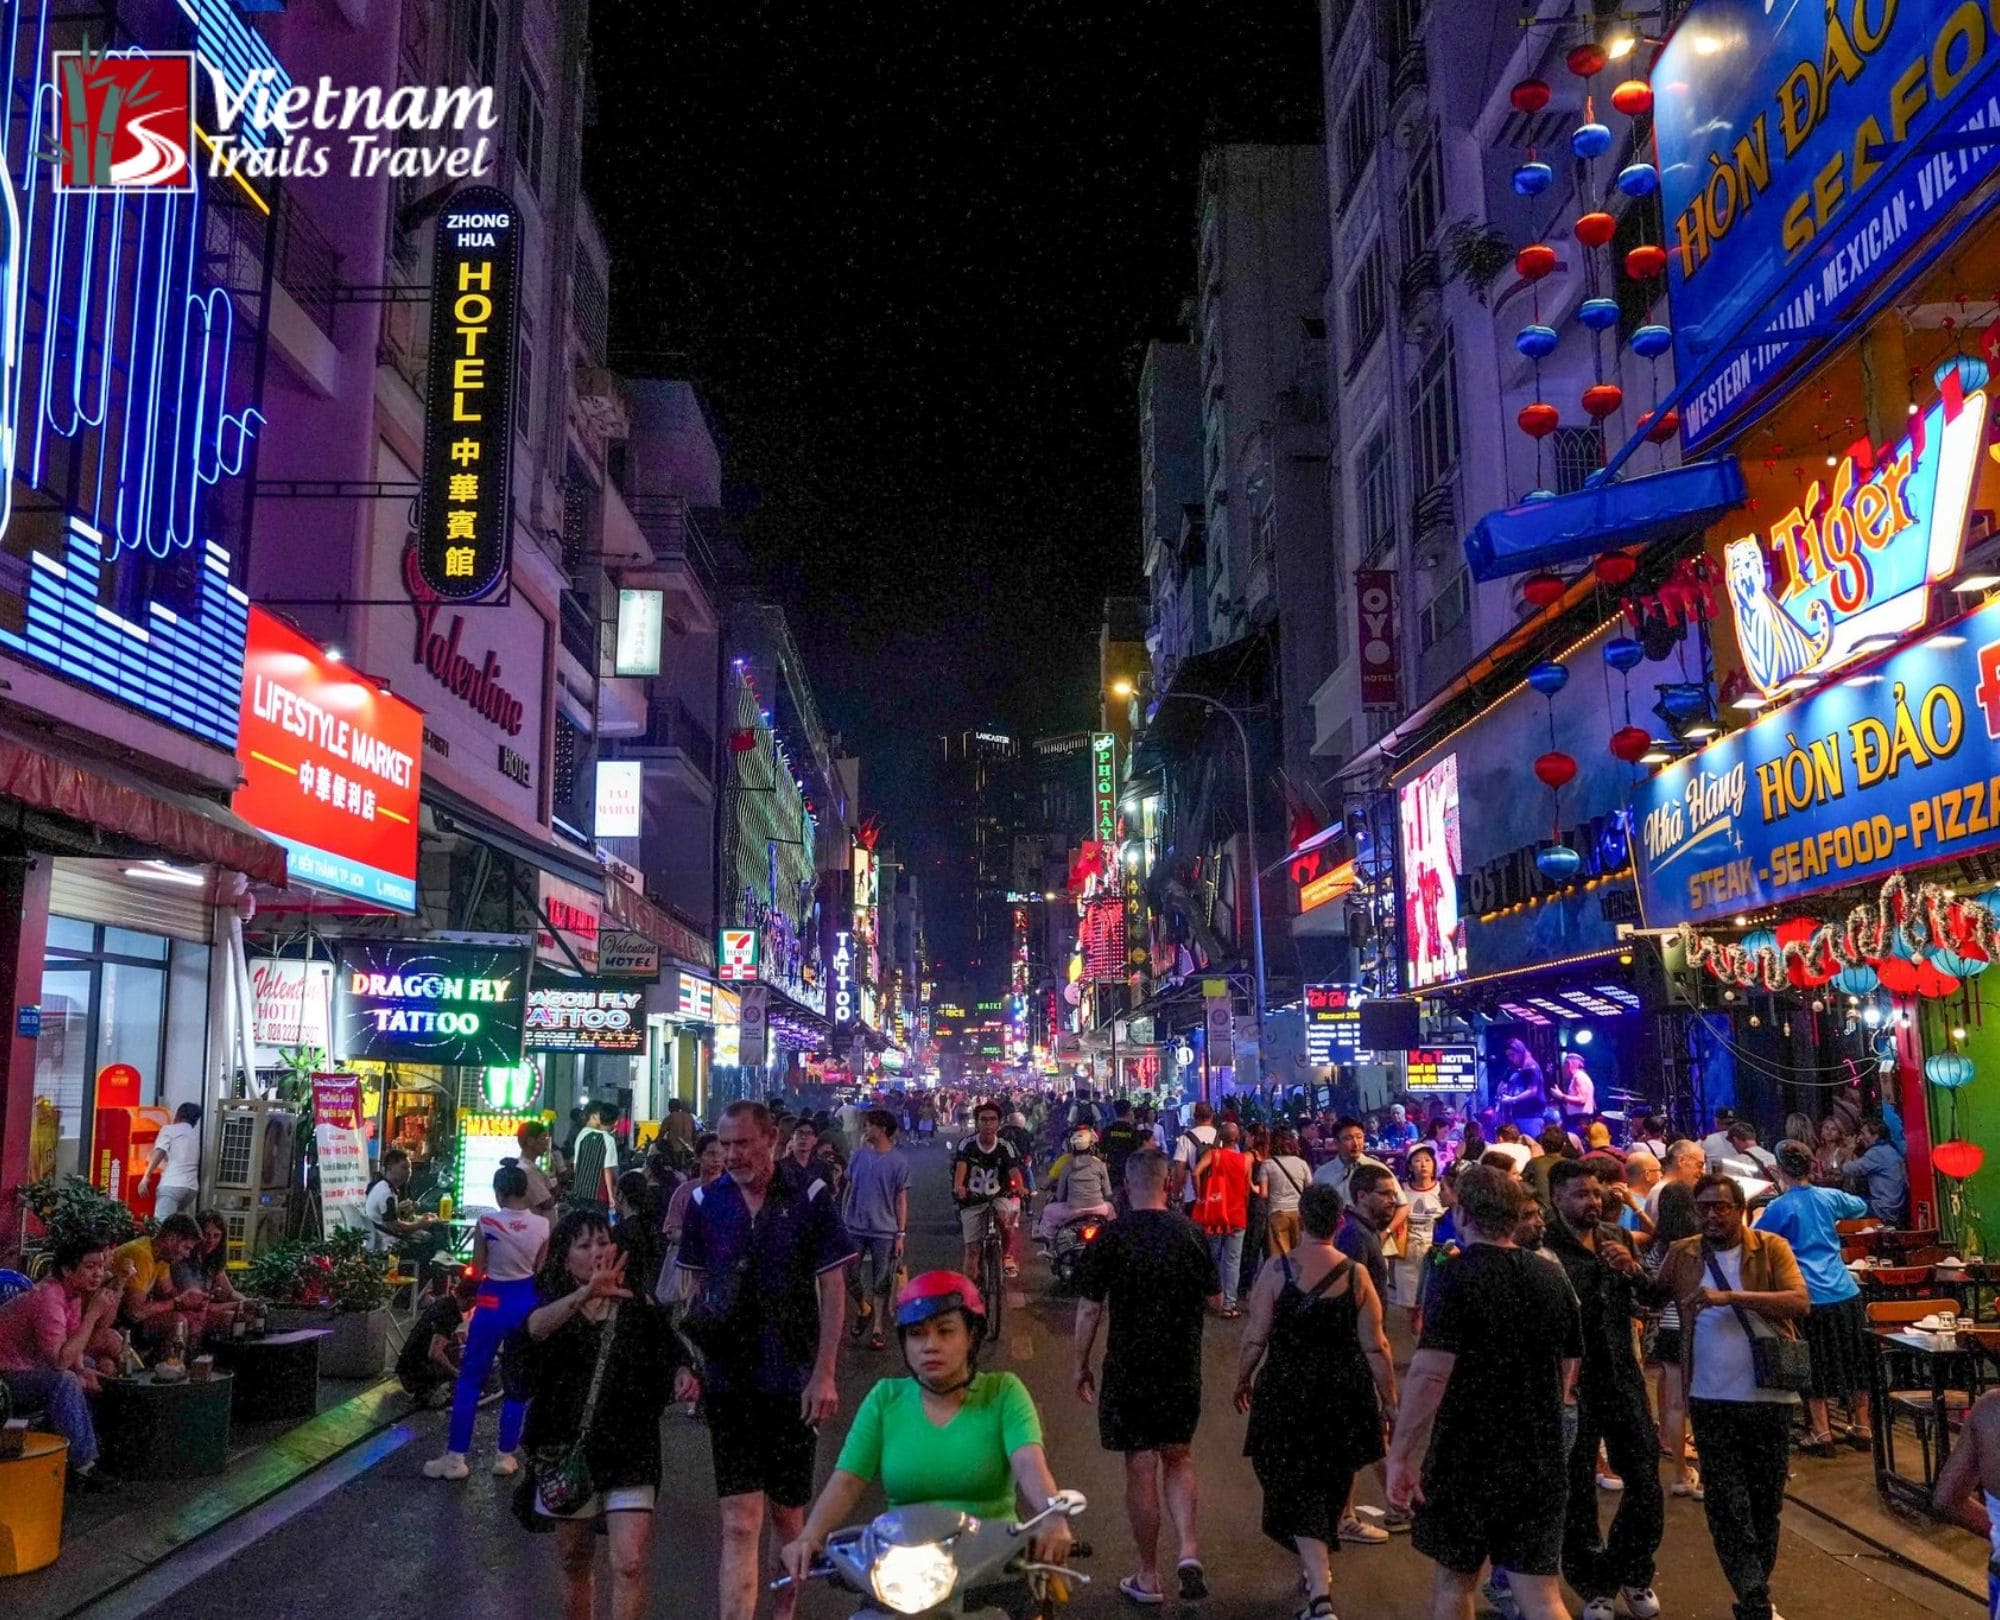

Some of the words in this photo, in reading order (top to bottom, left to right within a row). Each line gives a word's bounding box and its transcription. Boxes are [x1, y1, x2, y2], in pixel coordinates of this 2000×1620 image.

[1781, 0, 2000, 256] SEAFO
[446, 214, 510, 229] ZHONG
[1674, 111, 1770, 281] HÒN
[457, 233, 495, 248] HUA
[452, 261, 493, 423] HOTEL
[1685, 350, 1751, 440] WESTERN
[1821, 191, 1909, 306] MEXICAN
[444, 438, 481, 578] 中華賓館
[1771, 455, 1917, 614] Tiger
[404, 534, 524, 736] Valentine
[253, 674, 350, 759] LIFESTYLE
[351, 727, 414, 790] MARKET
[975, 732, 1010, 744] LANCASTER
[1755, 732, 1844, 824] HÒN
[1849, 680, 1964, 789] ĐẢO
[299, 759, 377, 823] 中華便利店
[1097, 752, 1112, 794] PHỐ
[1643, 798, 1685, 861] Nhà
[1684, 760, 1747, 828] Hàng
[1098, 799, 1114, 840] TÂY
[1688, 854, 1755, 909] STEAK
[1770, 812, 1894, 889] SEAFOOD
[601, 934, 656, 954] Valentine
[605, 957, 650, 967] HOTEL
[835, 932, 850, 1020] TATTOO
[352, 973, 465, 999] DRAGON
[468, 978, 512, 1002] FLY
[374, 1008, 480, 1035] TATTOO
[598, 992, 642, 1009] FLY
[1442, 1054, 1474, 1064] HOTEL
